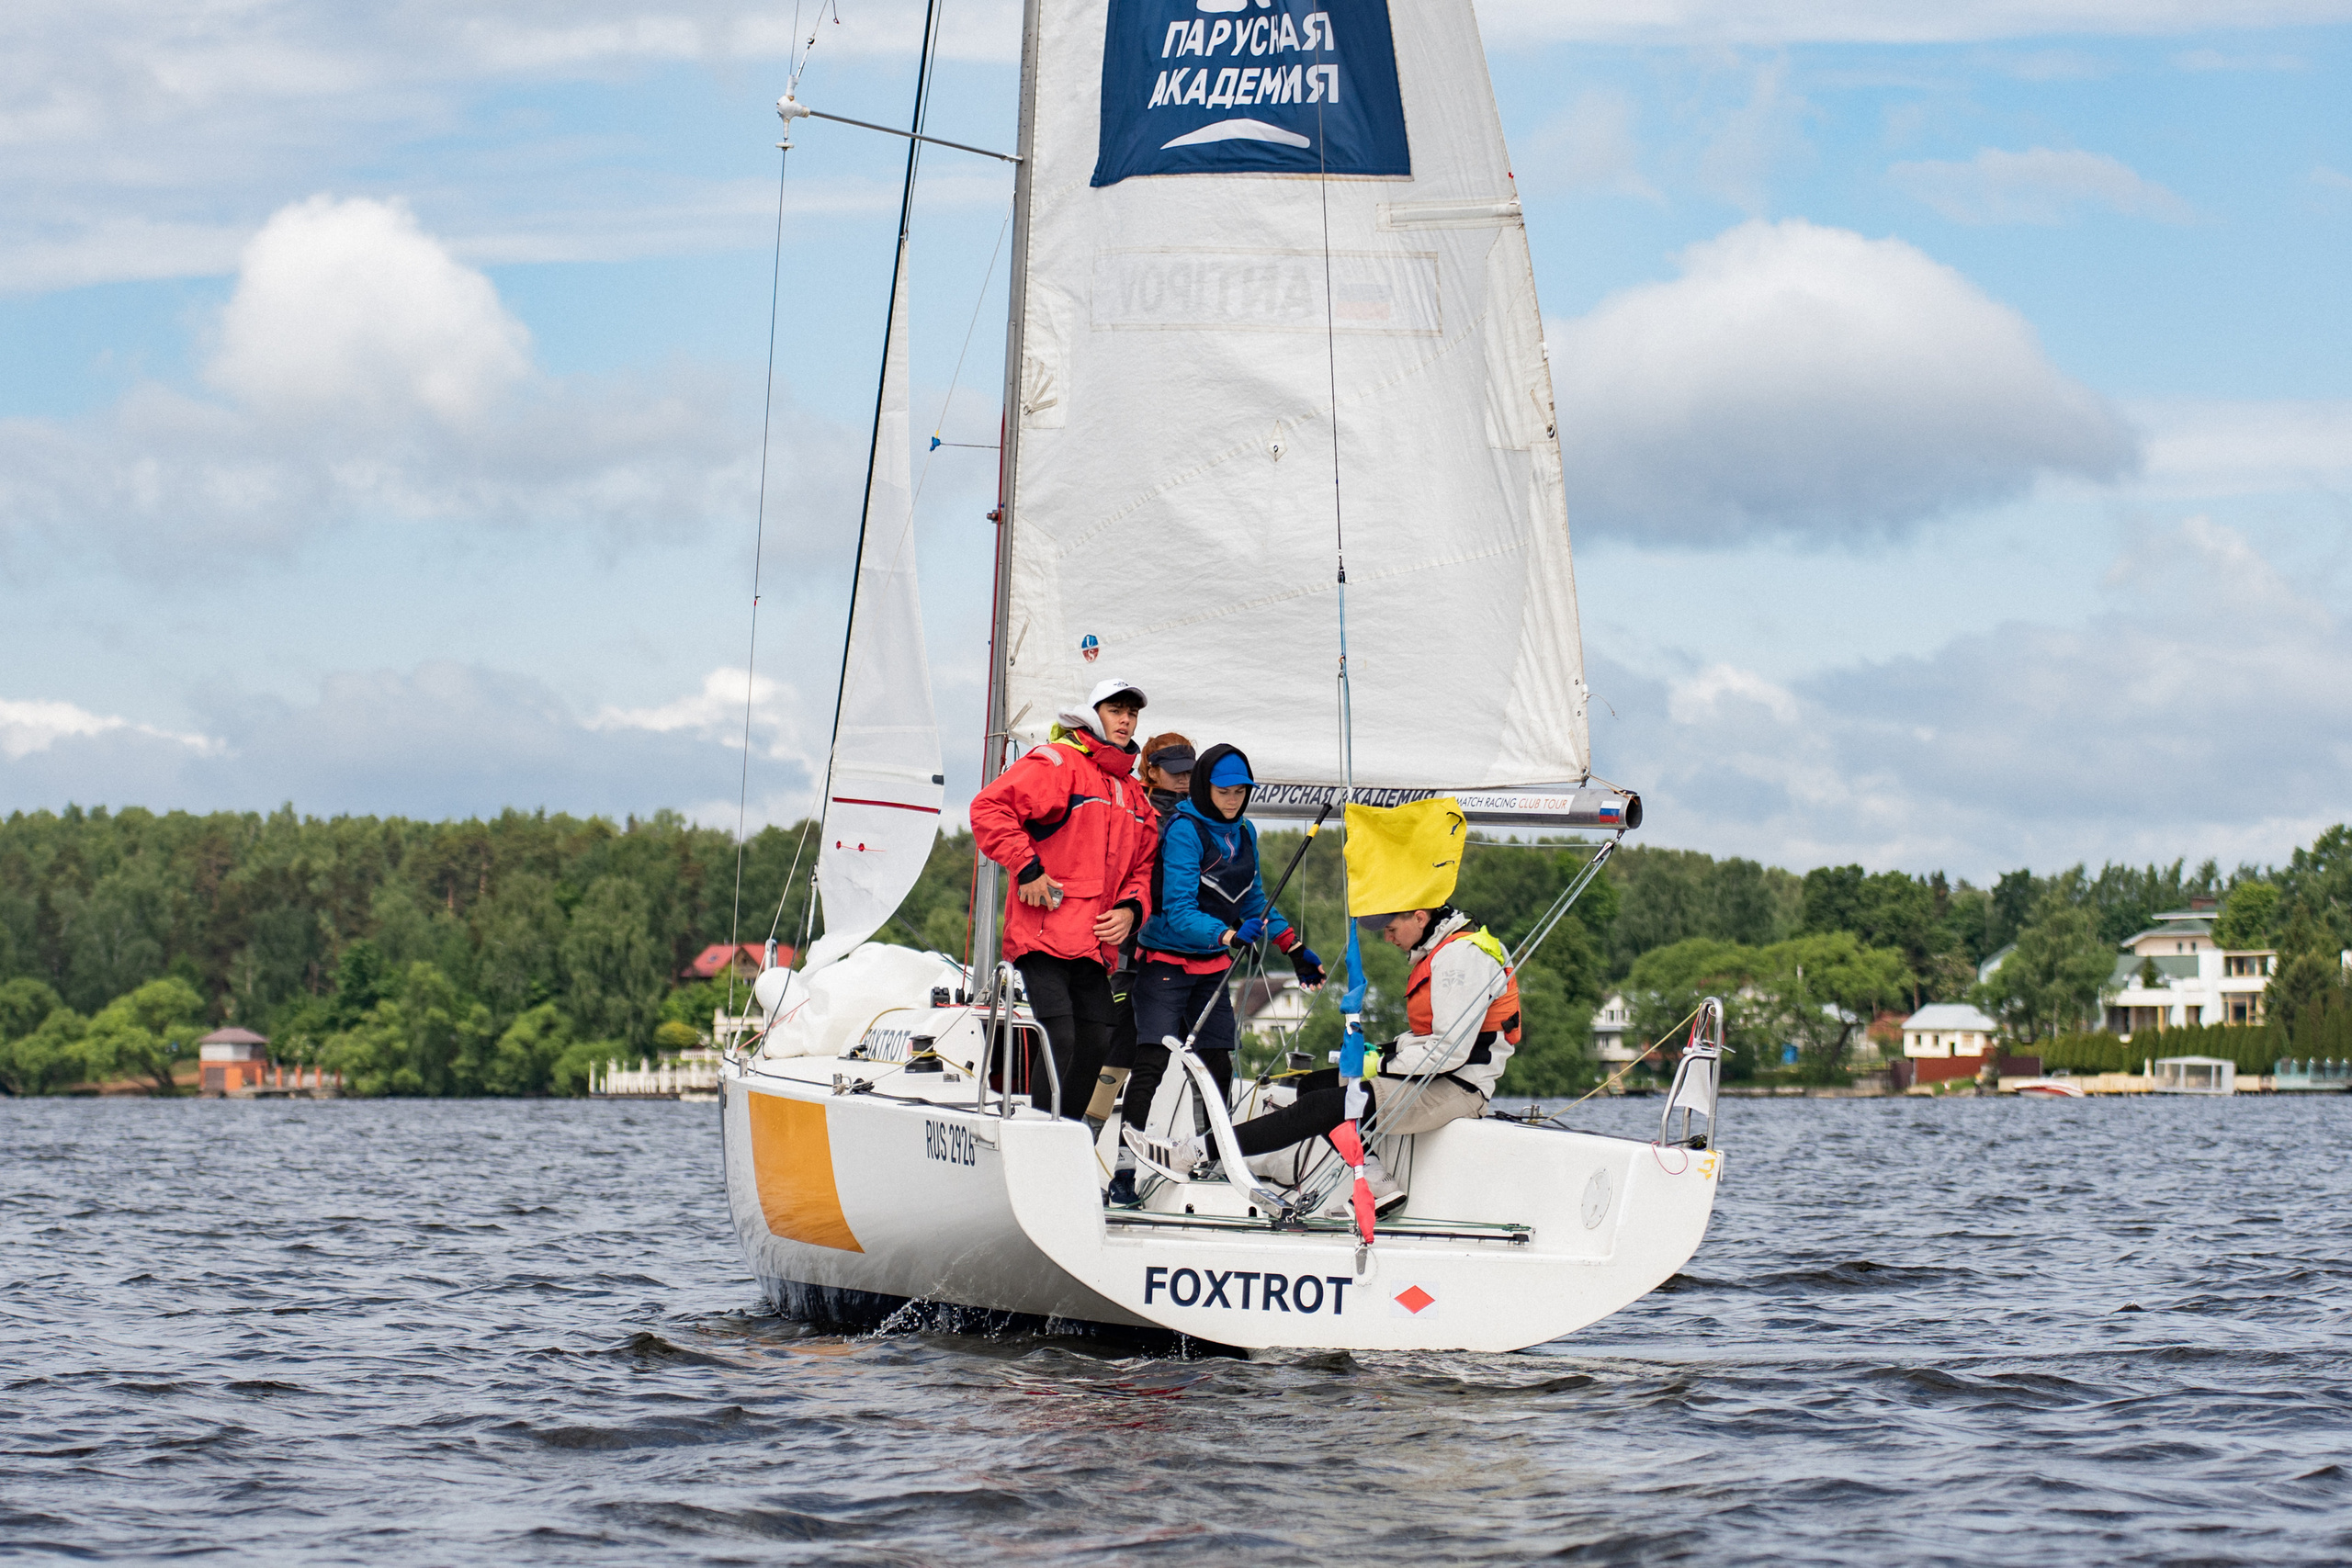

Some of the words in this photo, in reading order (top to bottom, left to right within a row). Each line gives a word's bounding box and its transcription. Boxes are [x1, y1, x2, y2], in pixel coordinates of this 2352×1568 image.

[1160, 11, 1335, 59] ПАРУСНАЯ
[1147, 63, 1340, 110] АКАДЕМИЯ
[1484, 797, 1517, 808] RACING
[1518, 797, 1540, 809] CLUB
[1543, 798, 1568, 810] TOUR
[925, 1120, 947, 1162] RUS
[949, 1123, 975, 1167] 2926
[1144, 1266, 1353, 1315] FOXTROT
